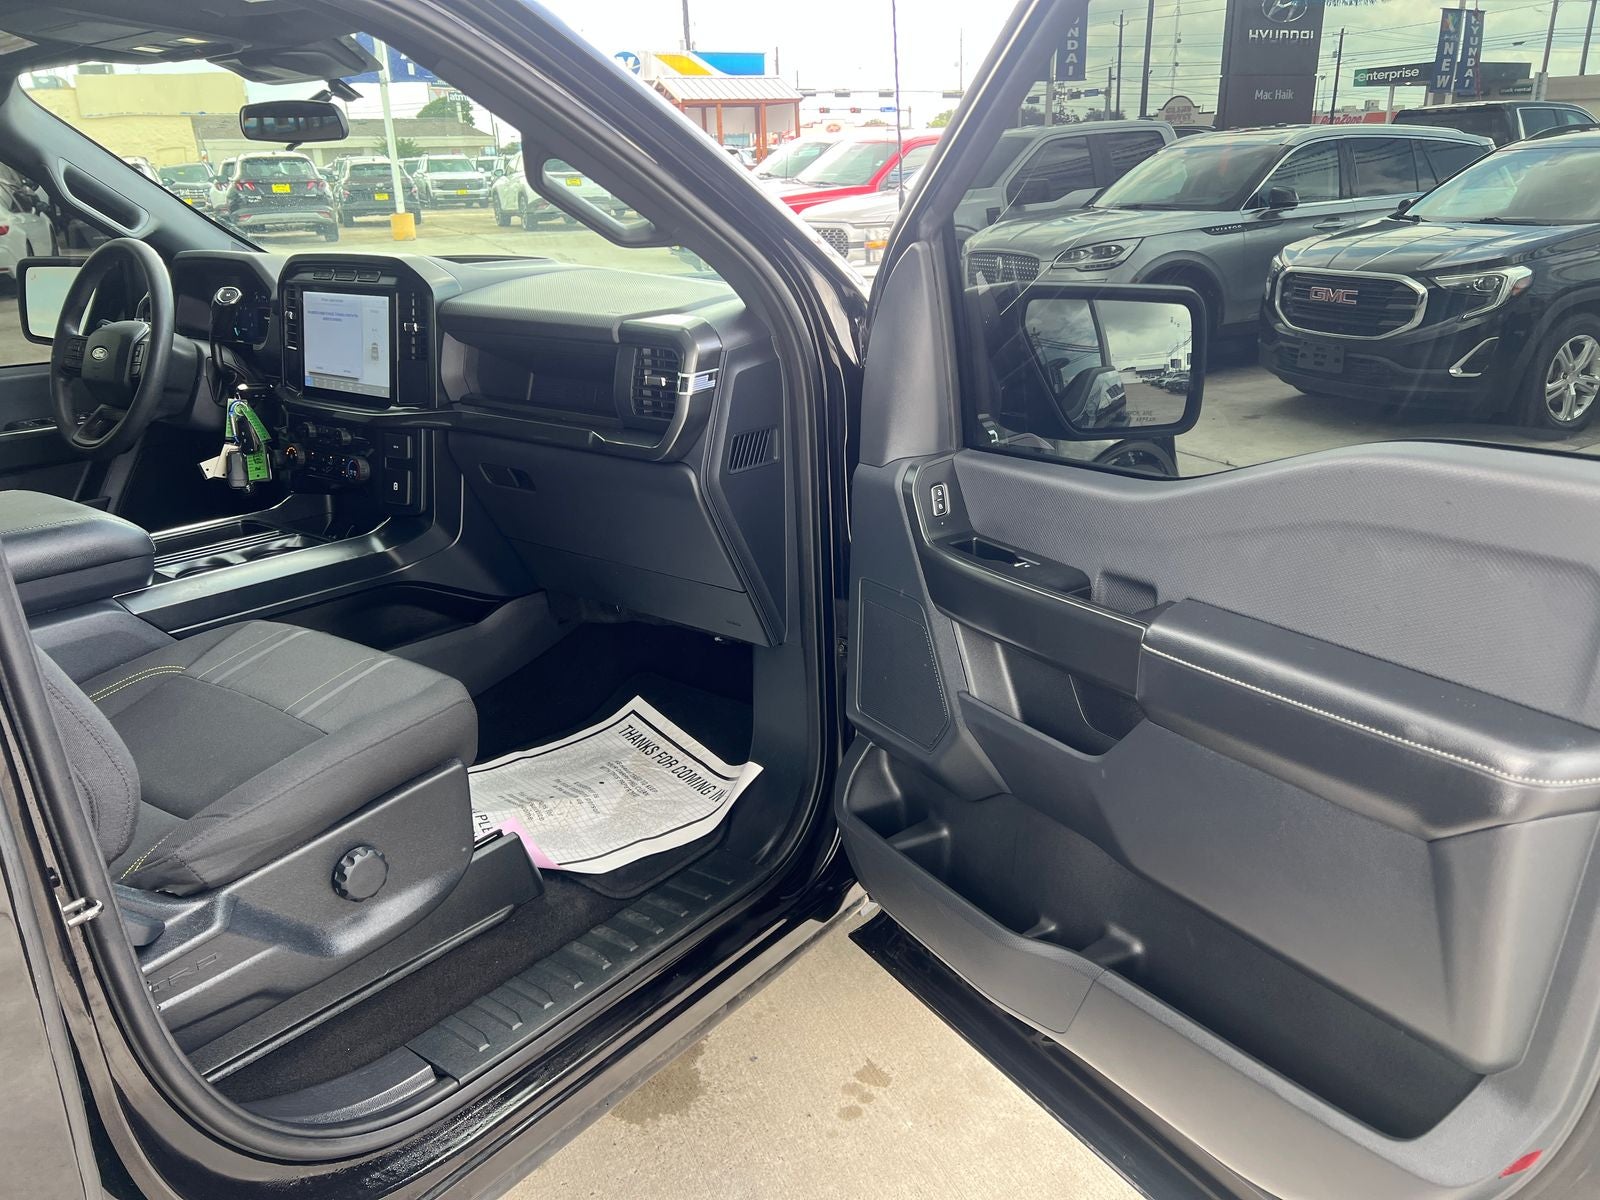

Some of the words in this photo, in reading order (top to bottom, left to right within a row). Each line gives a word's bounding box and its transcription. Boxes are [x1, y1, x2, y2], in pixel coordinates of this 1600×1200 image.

[1249, 29, 1314, 39] HYUNDAI
[1065, 16, 1080, 76] NDAI
[1436, 41, 1454, 89] NEW
[1356, 68, 1419, 82] enterprise
[1255, 89, 1273, 100] Mac
[1275, 89, 1295, 100] Haik
[1310, 286, 1358, 305] GMC
[619, 724, 660, 756] THANKS
[652, 751, 679, 769] FOR
[671, 765, 716, 796] COMING
[708, 788, 728, 802] IN
